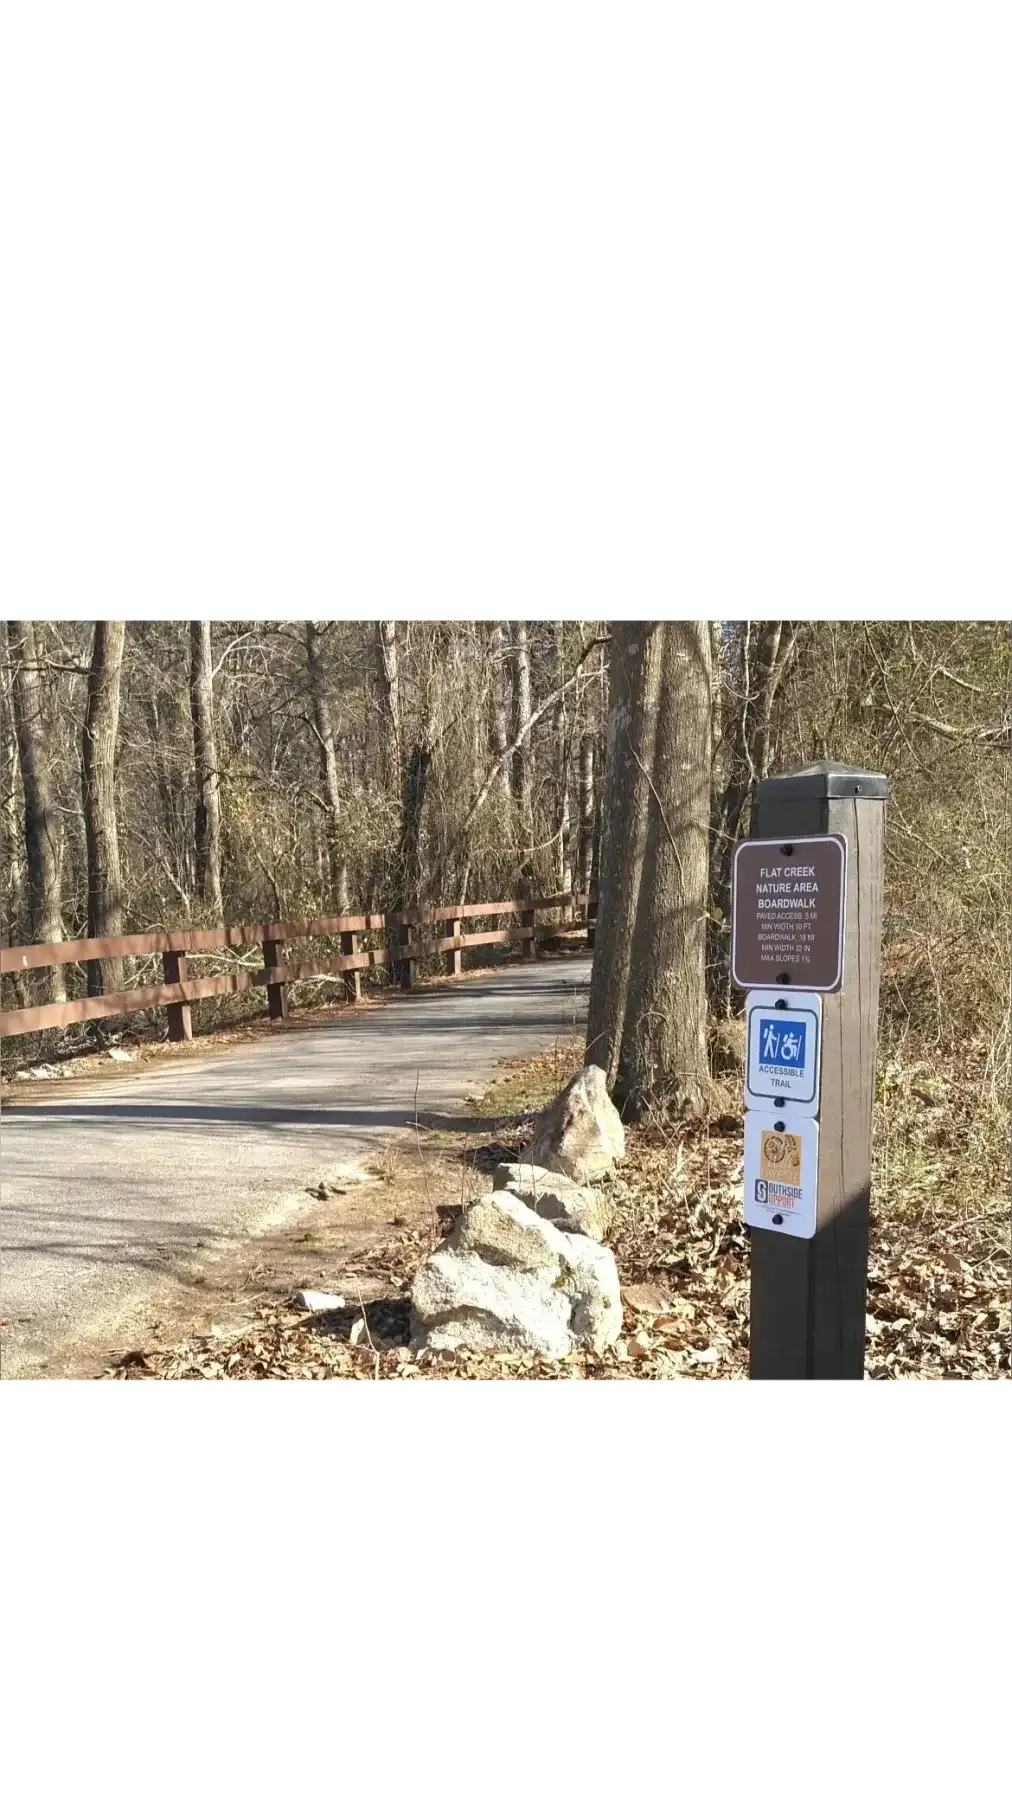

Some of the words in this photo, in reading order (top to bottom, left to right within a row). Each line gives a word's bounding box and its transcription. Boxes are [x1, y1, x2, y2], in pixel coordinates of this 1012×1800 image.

[760, 868, 782, 878] FLAT
[784, 866, 815, 877] CREEK
[756, 883, 791, 893] NATURE
[793, 882, 819, 892] AREA
[758, 898, 816, 908] BOARDWALK
[756, 912, 776, 920] PAVED
[777, 912, 802, 920] ACCESS
[761, 923, 773, 931] MIN
[774, 923, 794, 931] WIDTH
[804, 923, 812, 931] FT
[758, 933, 796, 941] BOARDWALK
[761, 944, 773, 952] MIN
[774, 944, 794, 952] WIDTH
[804, 944, 811, 952] IN
[775, 955, 800, 963] SLOPES
[759, 1065, 804, 1078] ACCESSIBLE
[771, 1078, 791, 1088] TRAIL
